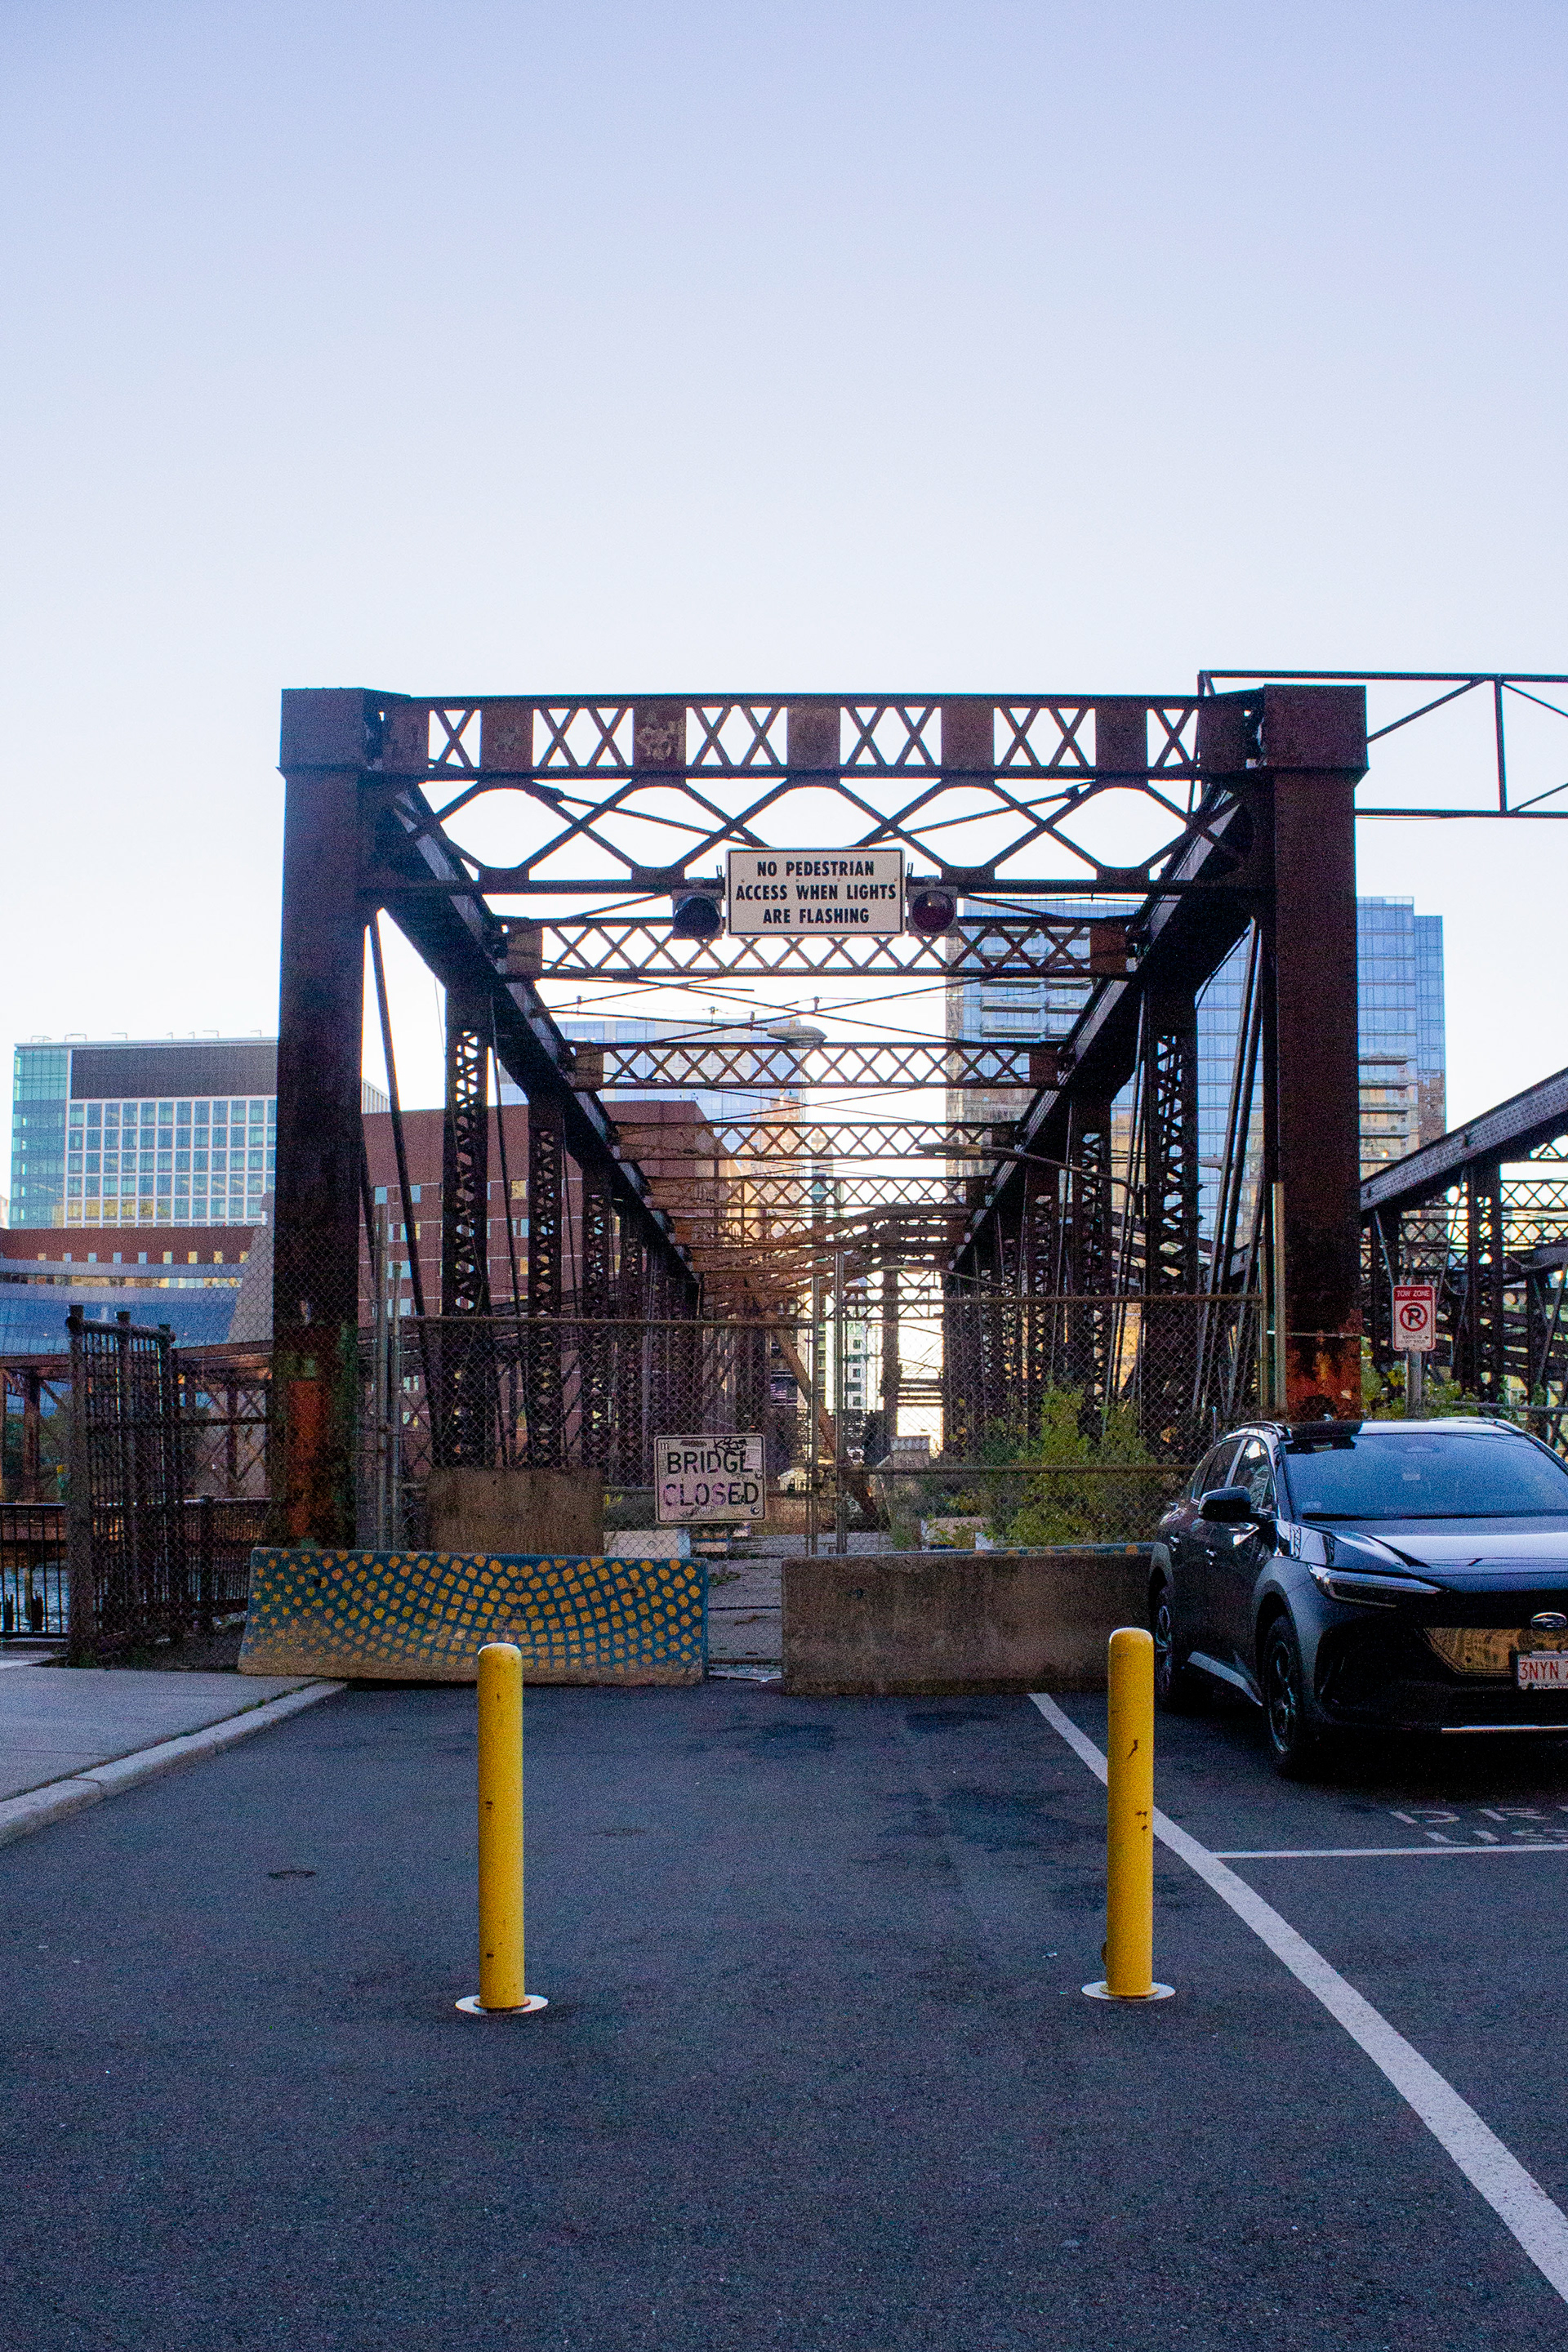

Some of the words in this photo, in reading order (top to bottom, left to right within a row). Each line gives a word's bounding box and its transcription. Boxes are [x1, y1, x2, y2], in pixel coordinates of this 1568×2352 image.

[756, 861, 777, 877] NO
[786, 860, 875, 877] PEDESTRIAN
[736, 884, 788, 901] ACCESS
[796, 884, 839, 900] WHEN
[846, 884, 897, 900] LIGHTS
[763, 908, 791, 924] ARE
[800, 907, 870, 924] FLASHING
[667, 1451, 753, 1474] BRIDGE
[664, 1482, 759, 1505] CLOSED
[1519, 1661, 1559, 1680] 3NYN
